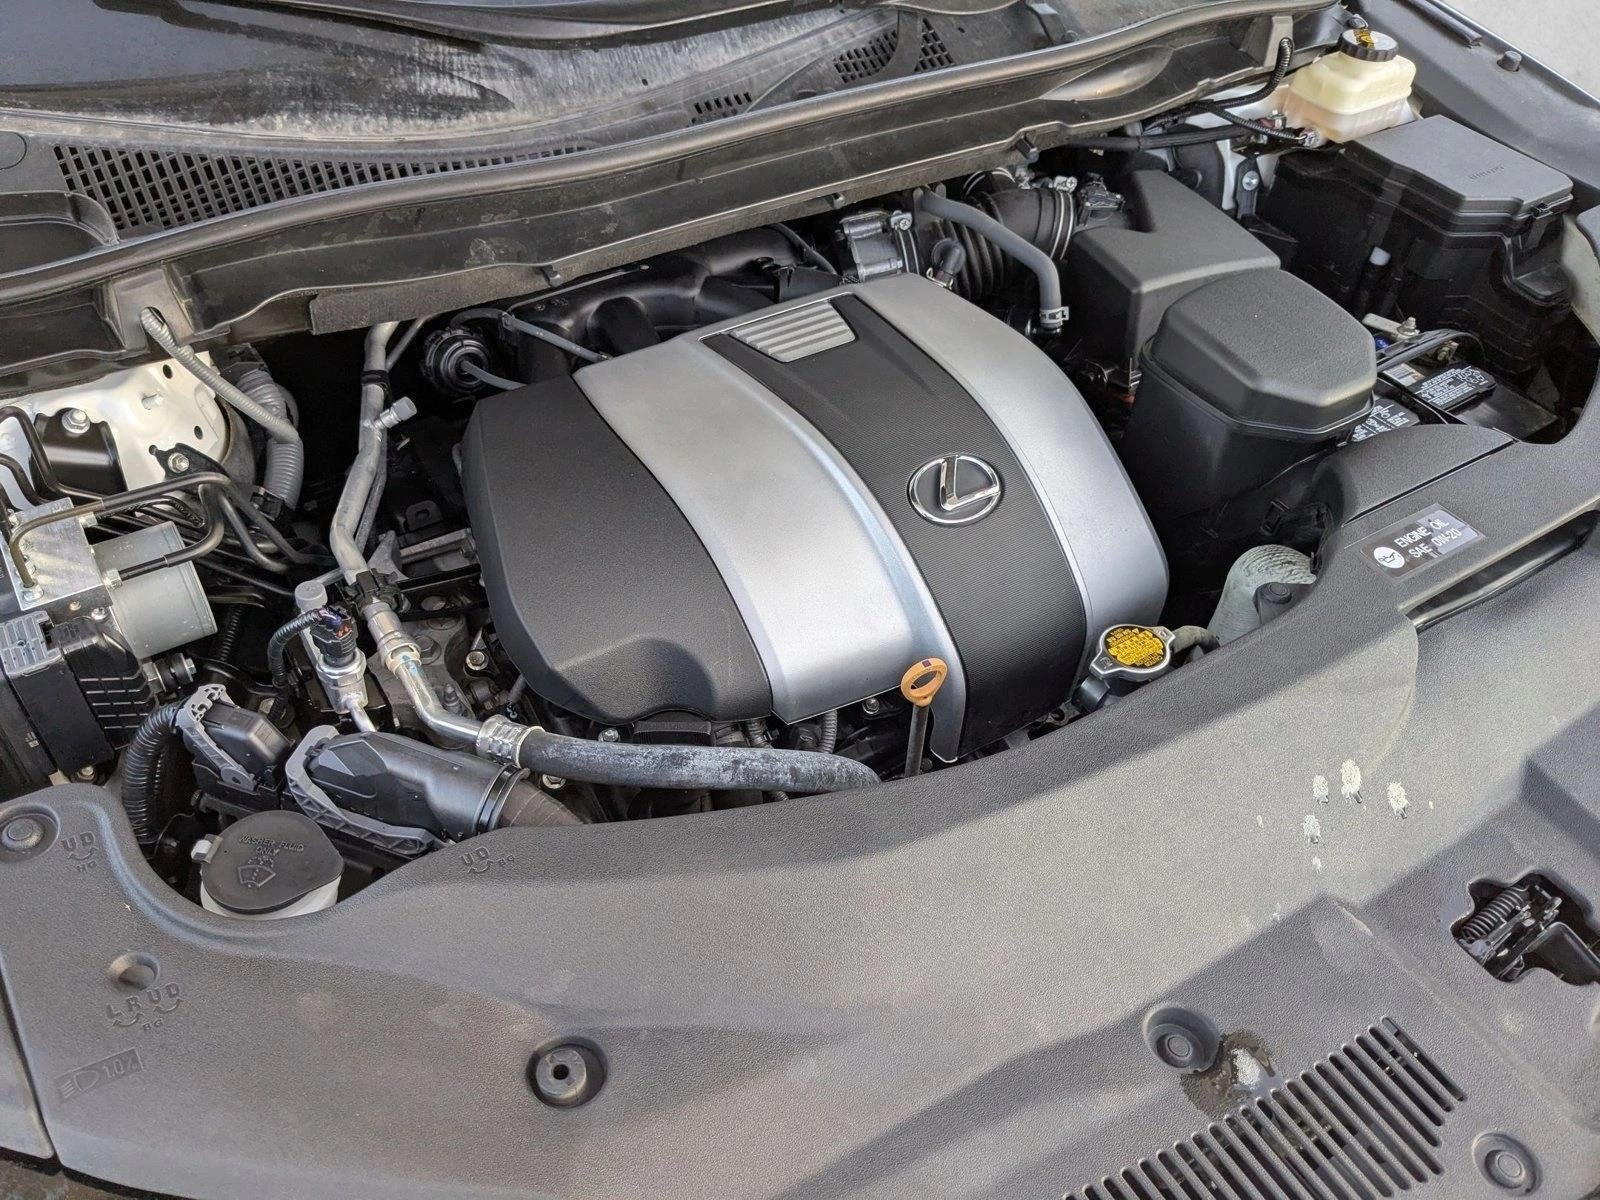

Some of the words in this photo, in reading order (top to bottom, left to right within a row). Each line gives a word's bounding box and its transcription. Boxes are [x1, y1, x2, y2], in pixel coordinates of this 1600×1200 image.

[1394, 527, 1431, 547] ENGINE
[1430, 518, 1449, 530] OIL
[1408, 545, 1432, 558] SAE
[1431, 528, 1462, 547] 0W-20
[239, 835, 275, 847] WASHER
[279, 840, 304, 852] FLUID
[256, 846, 280, 856] ONLY
